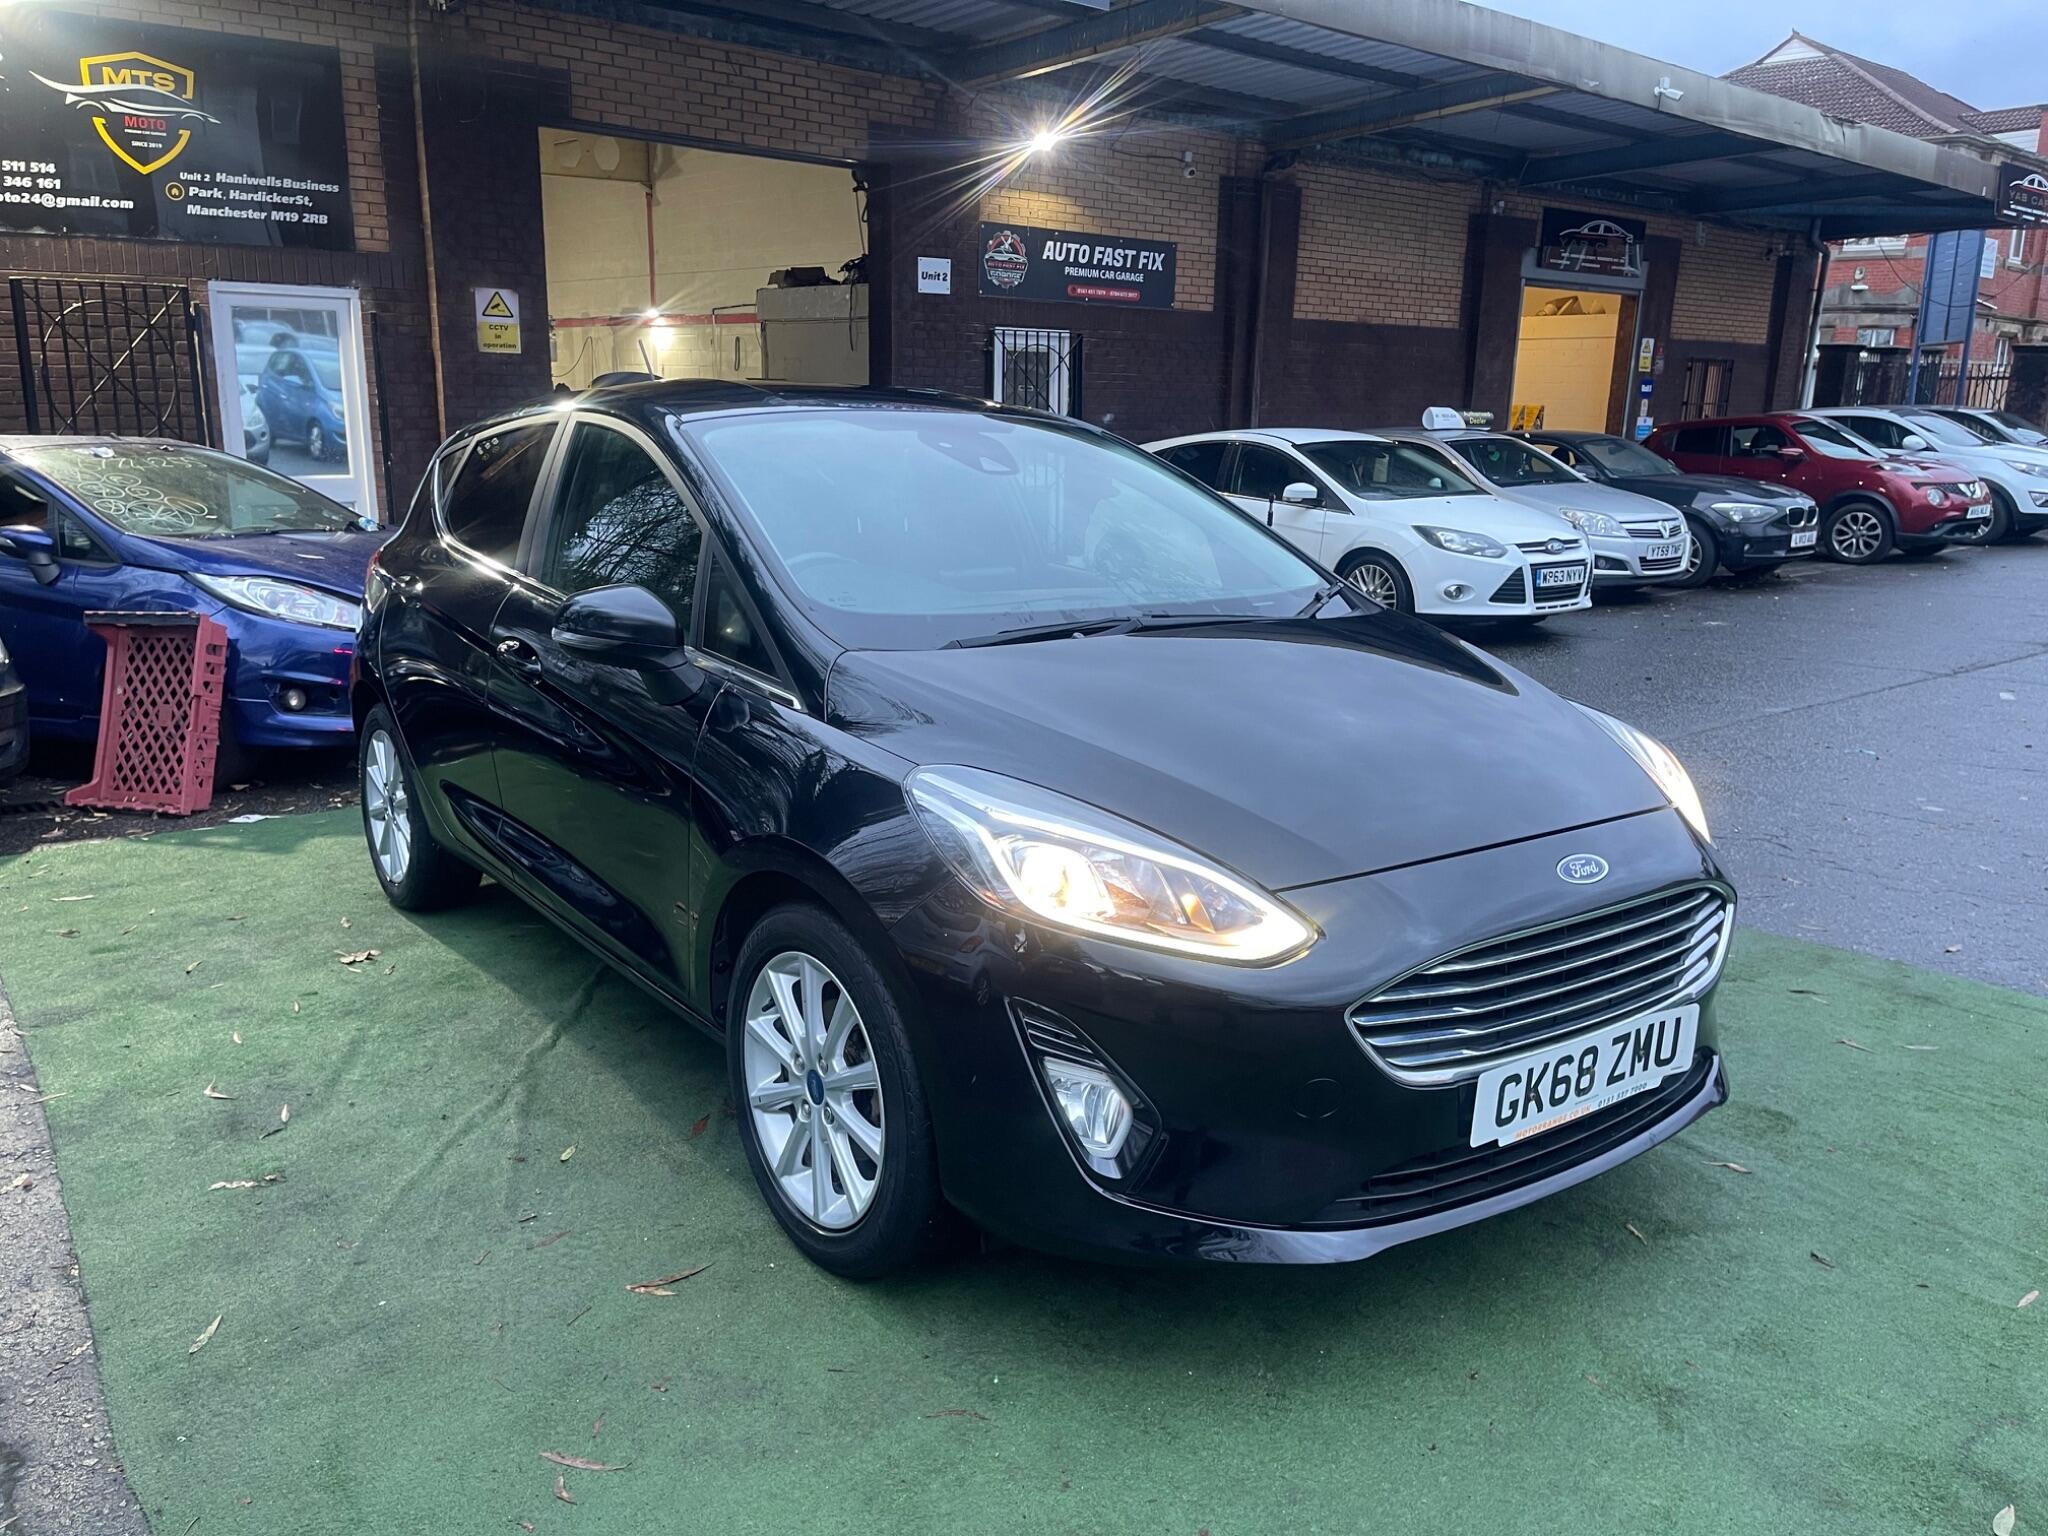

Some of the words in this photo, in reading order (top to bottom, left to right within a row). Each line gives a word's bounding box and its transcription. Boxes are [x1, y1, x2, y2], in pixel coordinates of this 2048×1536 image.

[102, 66, 176, 92] MTS
[124, 115, 167, 131] MOTO
[131, 140, 148, 148] SINCE
[1, 159, 26, 173] 511
[29, 161, 57, 174] 514
[2, 175, 33, 189] 346
[36, 177, 61, 190] 161
[179, 171, 202, 182] Unit
[203, 172, 211, 182] 2
[186, 203, 268, 221] Manchester
[270, 210, 299, 223] M19
[302, 212, 329, 226] 2RB
[1042, 240, 1091, 264] AUTO
[1093, 245, 1137, 268] FAST
[1138, 250, 1166, 272] FIX
[921, 271, 941, 281] Unit
[941, 272, 948, 282] 2
[1064, 265, 1099, 279] PREMIUM
[1099, 268, 1115, 280] CAR
[1115, 271, 1145, 283] GARAGE
[482, 342, 517, 350] operation
[1542, 568, 1565, 584] WP63
[1566, 566, 1584, 582] NYV
[1569, 859, 1599, 878] Ford
[1495, 1045, 1599, 1128] GK68
[1606, 1016, 1682, 1087] ZMU
